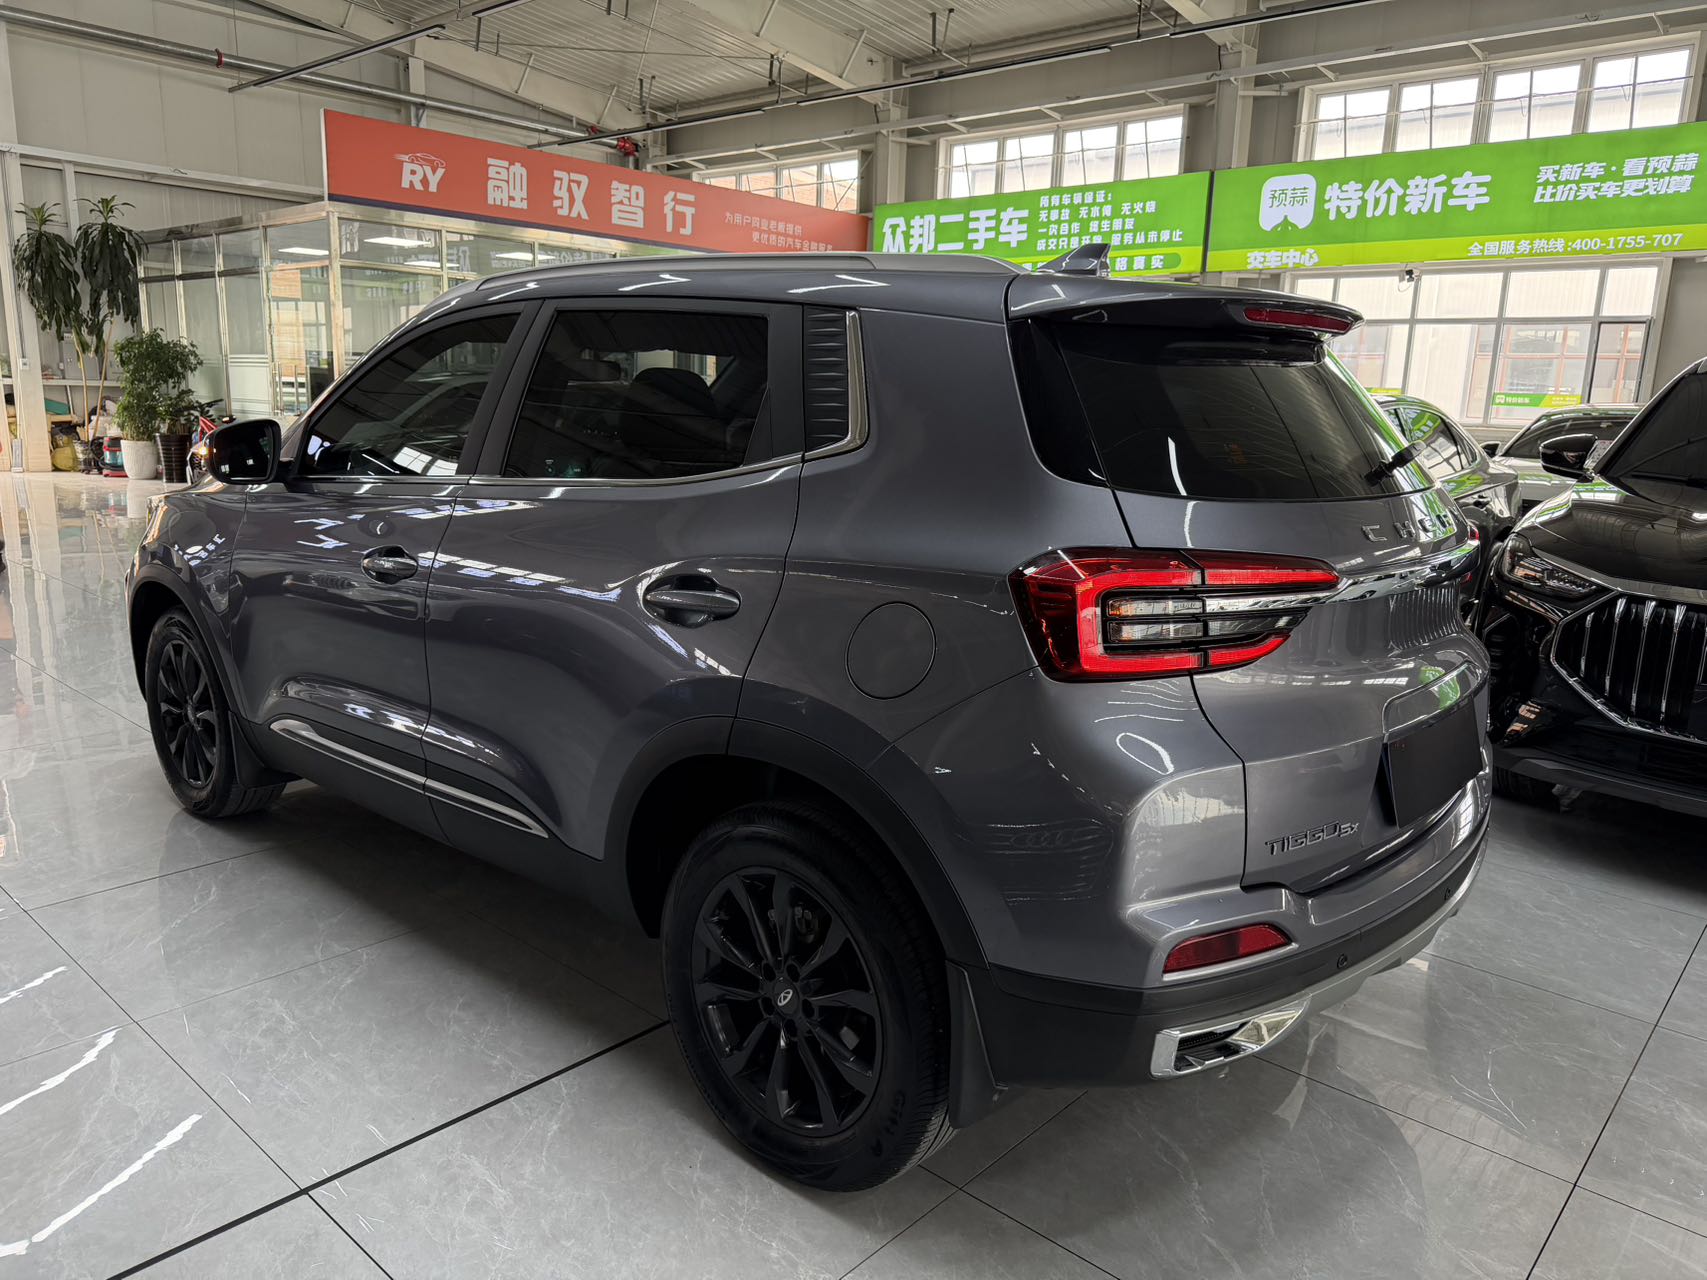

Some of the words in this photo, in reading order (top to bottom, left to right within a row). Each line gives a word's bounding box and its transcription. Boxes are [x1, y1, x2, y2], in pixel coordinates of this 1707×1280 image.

[401, 161, 446, 193] RY
[1533, 175, 1695, 203] 比价买车更划算
[487, 157, 696, 236] 融驭智行
[1268, 186, 1309, 208] 预蒜
[1324, 171, 1492, 221] 特价新车
[1038, 208, 1071, 222] 无事故
[882, 206, 1029, 253] 众邦二手车
[1038, 222, 1081, 236] 一次合作
[1111, 229, 1183, 246] 服务从未停止
[1247, 248, 1319, 269] 交车中心
